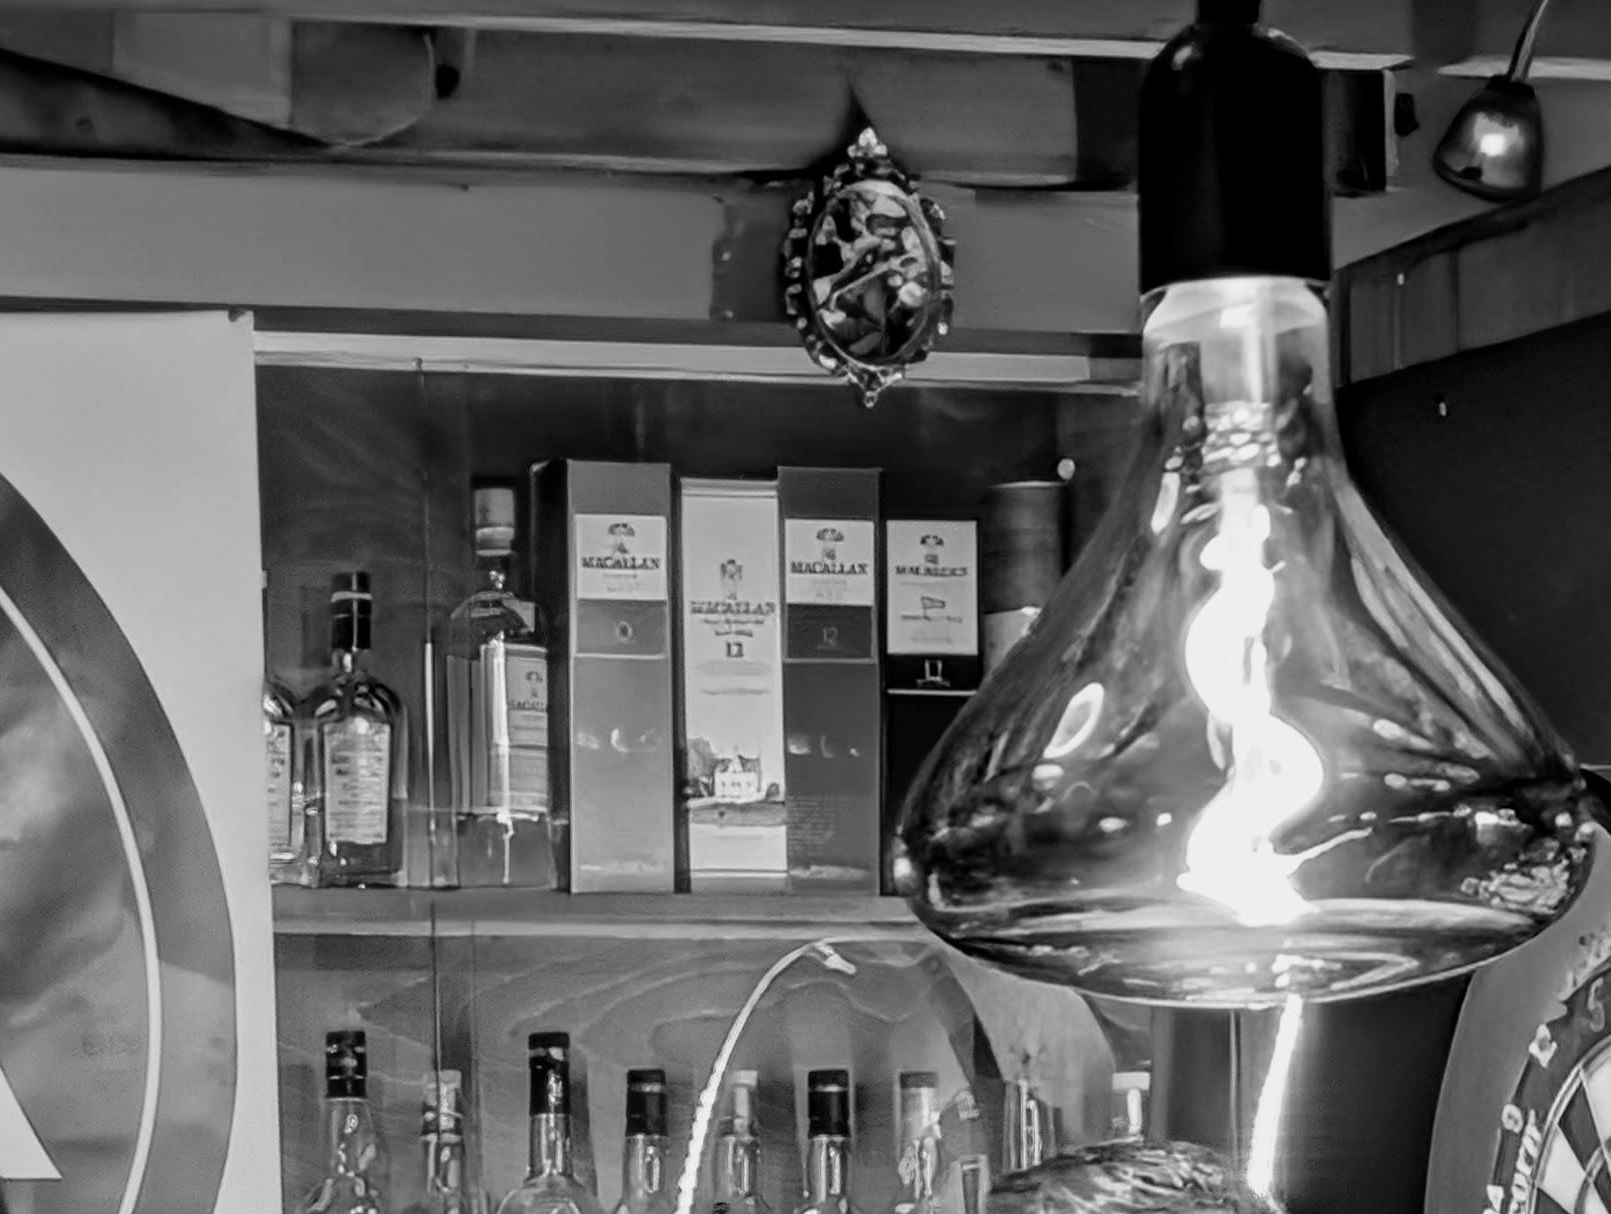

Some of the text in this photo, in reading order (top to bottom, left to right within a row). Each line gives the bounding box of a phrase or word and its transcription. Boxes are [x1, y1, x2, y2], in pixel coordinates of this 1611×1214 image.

[581, 556, 661, 570] MACALLAN
[790, 561, 869, 576] MACALLAN
[895, 565, 968, 577] MACA
